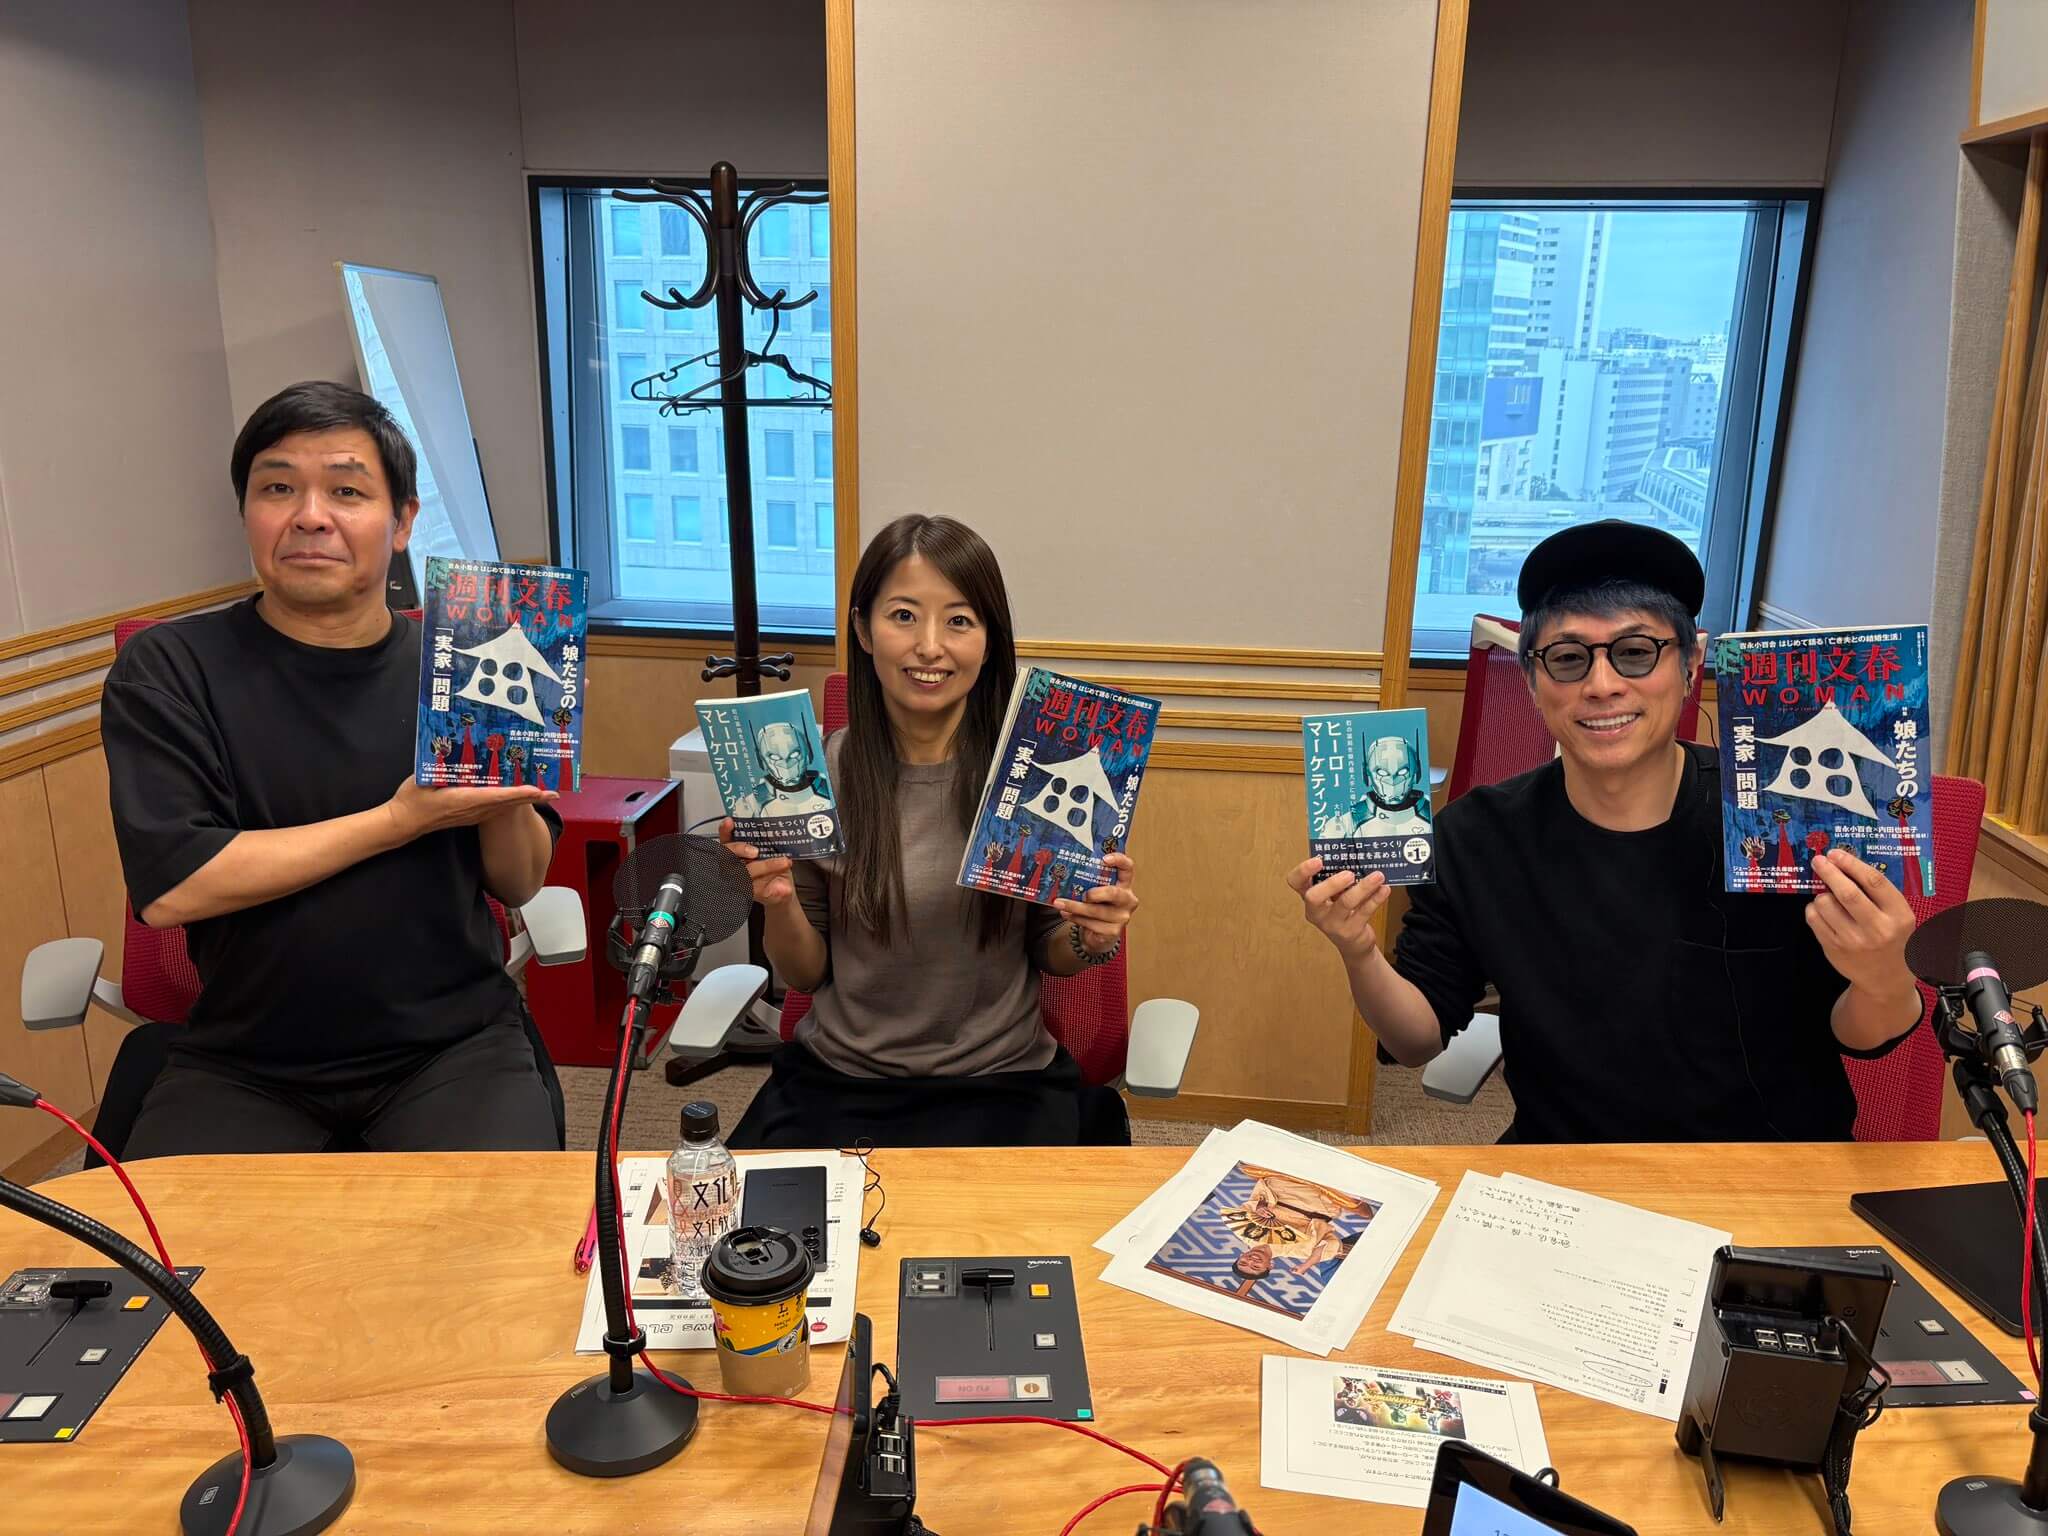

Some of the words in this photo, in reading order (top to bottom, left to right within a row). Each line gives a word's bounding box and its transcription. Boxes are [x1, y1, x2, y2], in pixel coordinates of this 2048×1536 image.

[446, 573, 573, 611] 週刊文春
[447, 606, 573, 628] WOMAN
[431, 626, 453, 712] 「実家」問題
[560, 644, 579, 709] 娘たちの
[1742, 645, 1903, 686] 週刊文春
[1743, 684, 1905, 706] WOMAN
[715, 709, 740, 772] ヒーロー
[1035, 717, 1144, 757] WOMAN
[1040, 687, 1149, 742] 週刊文春
[699, 709, 737, 810] マーケティング
[994, 737, 1037, 820] 「実家」問題
[1307, 721, 1329, 833] マーケティング
[1327, 720, 1345, 788] ヒーロー
[1733, 715, 1759, 810] 「実家」問題
[1893, 719, 1920, 798] 娘たちの
[1111, 774, 1140, 838] 娘たちの
[1314, 840, 1403, 852] 独自のヒーローをつくり
